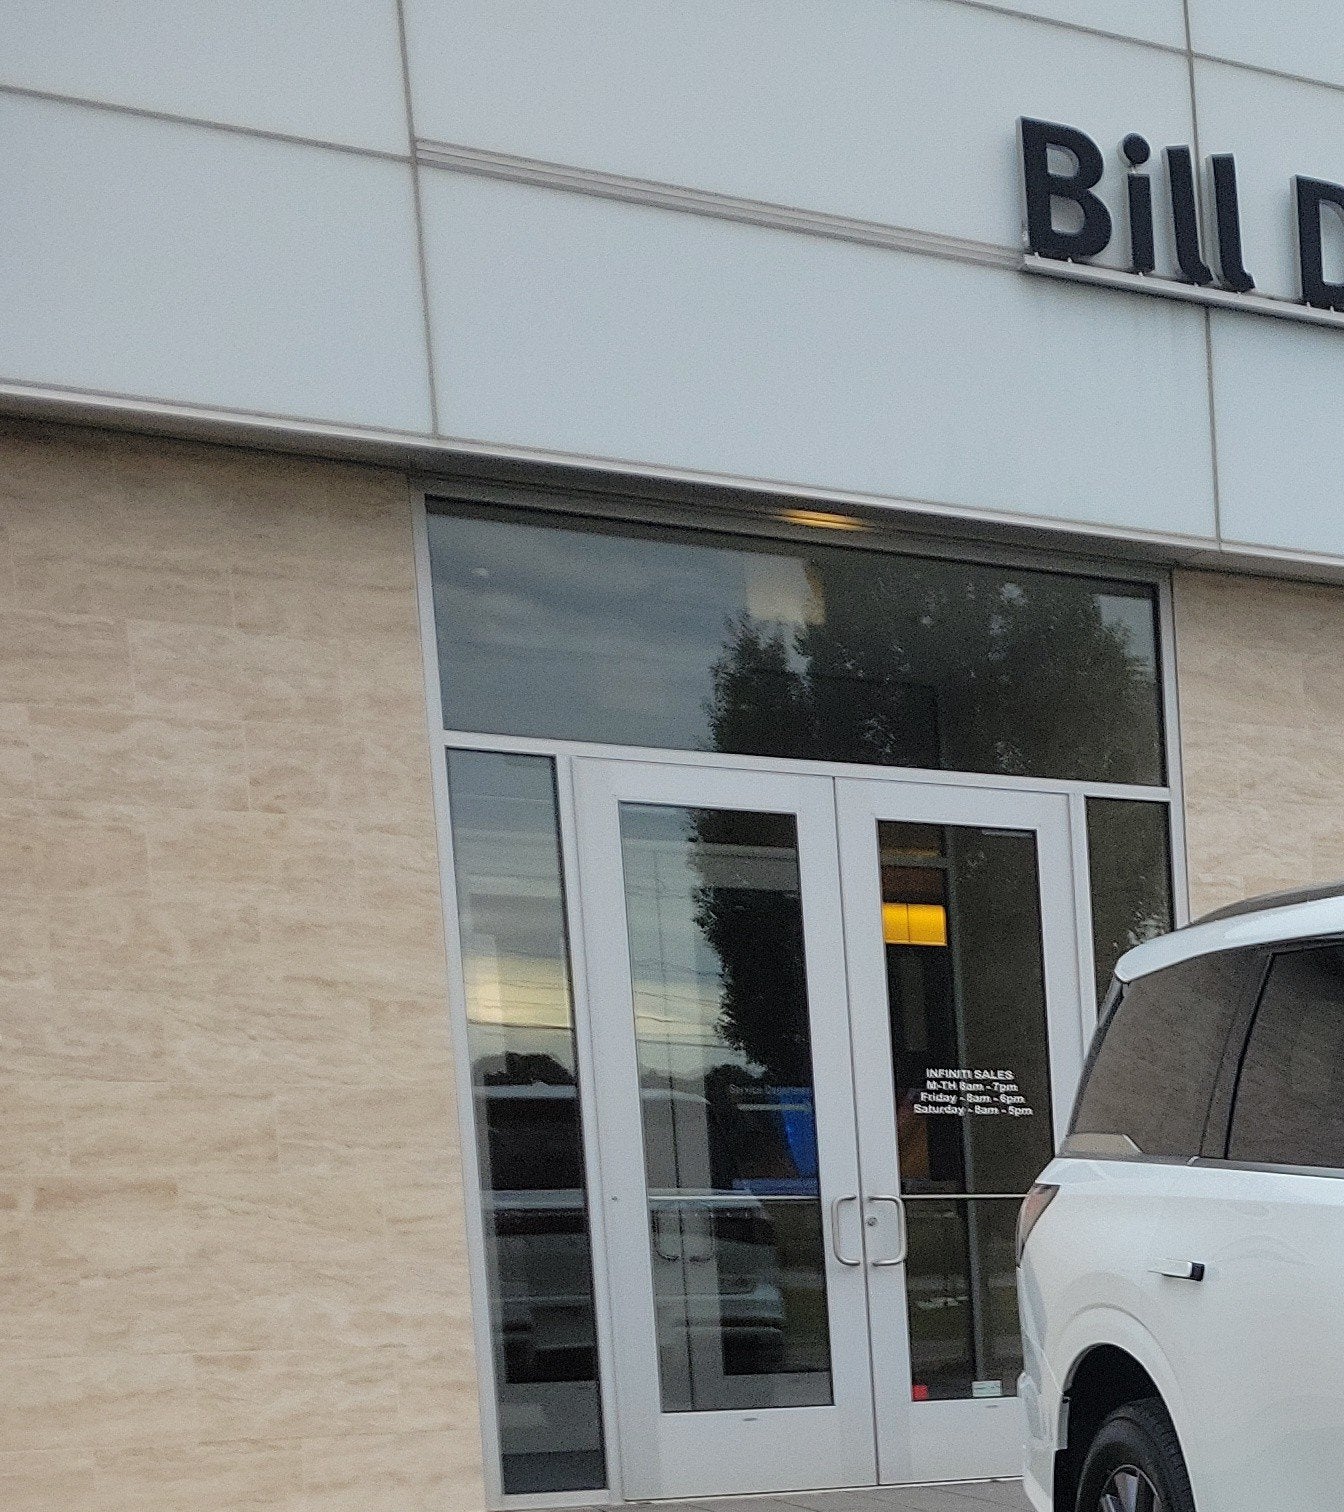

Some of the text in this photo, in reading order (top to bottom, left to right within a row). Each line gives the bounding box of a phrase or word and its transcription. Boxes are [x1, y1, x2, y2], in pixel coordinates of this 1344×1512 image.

[1016, 116, 1255, 292] Bill
[926, 1068, 1014, 1080] INFINITI SALES
[926, 1080, 958, 1091] M-TH
[992, 1082, 1018, 1093] 7pm
[920, 1092, 958, 1104] Friday
[914, 1104, 965, 1116] Saturday
